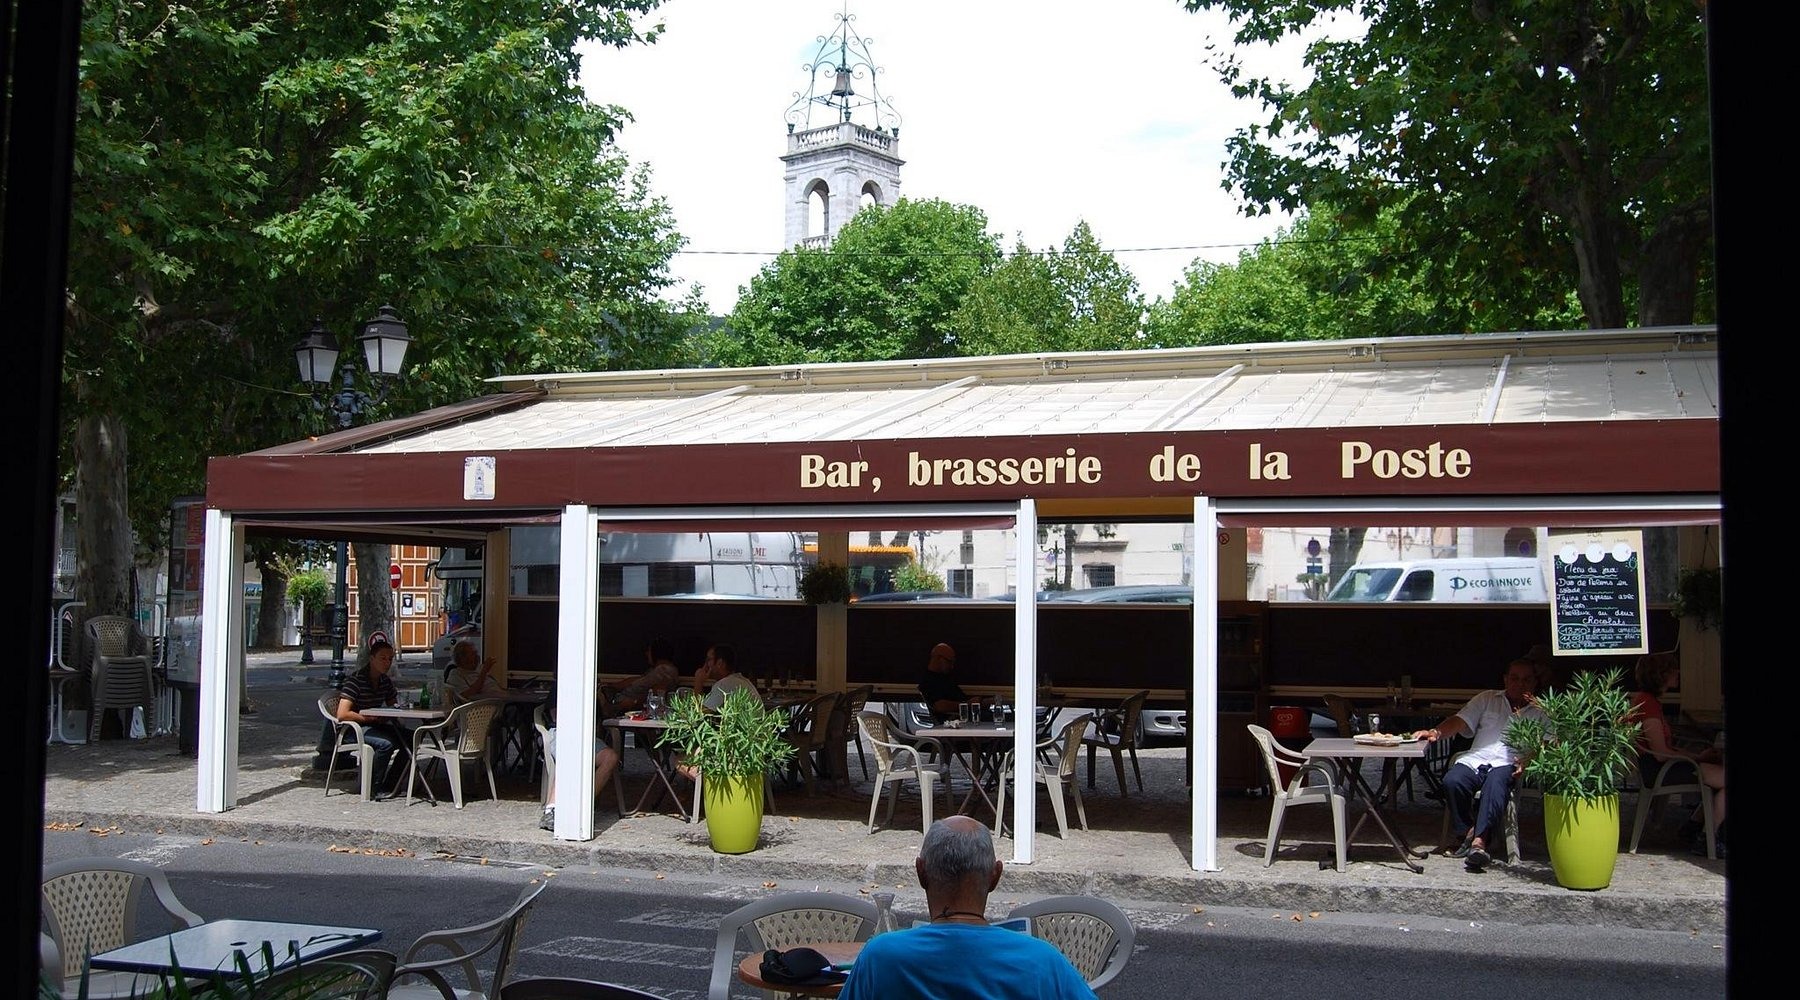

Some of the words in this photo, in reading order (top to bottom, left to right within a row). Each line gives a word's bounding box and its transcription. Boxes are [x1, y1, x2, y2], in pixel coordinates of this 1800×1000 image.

[801, 454, 881, 493] Bar,
[909, 448, 1102, 486] brasserie
[1149, 445, 1200, 481] de
[1250, 443, 1292, 480] la
[1341, 441, 1472, 478] Poste
